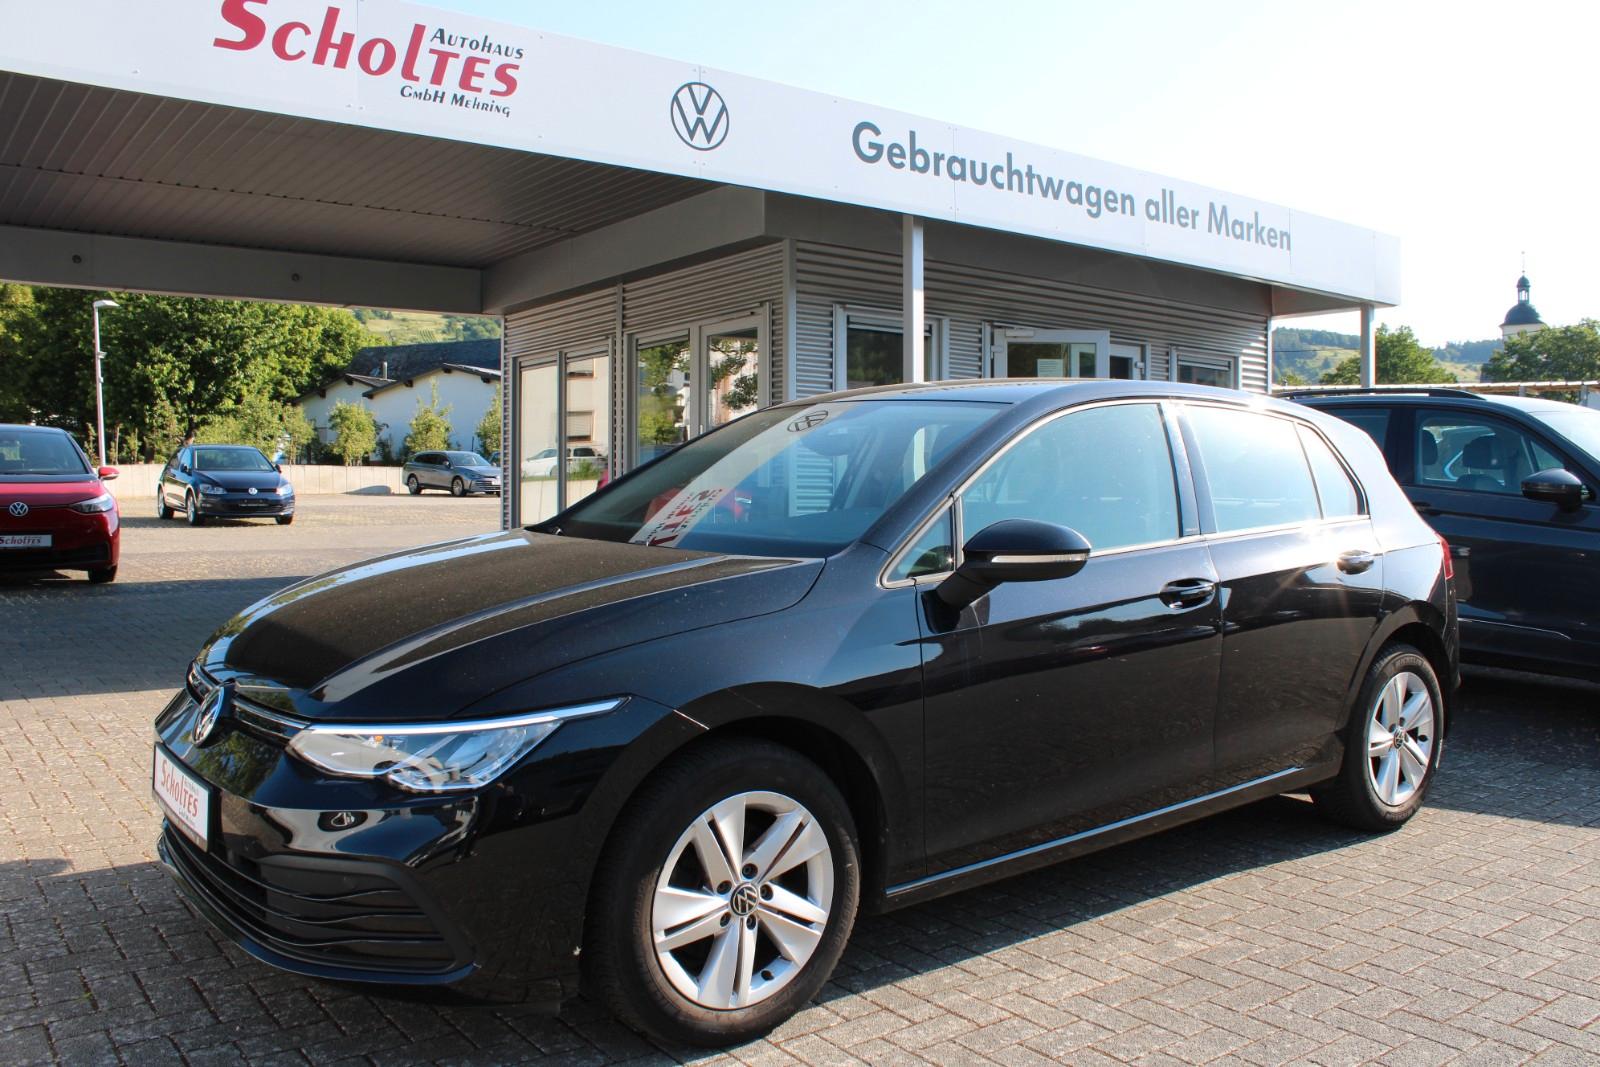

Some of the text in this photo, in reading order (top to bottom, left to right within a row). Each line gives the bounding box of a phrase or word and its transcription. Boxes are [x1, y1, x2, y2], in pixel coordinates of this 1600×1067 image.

[852, 121, 1291, 251] Gebrauchtwagen aller Marken
